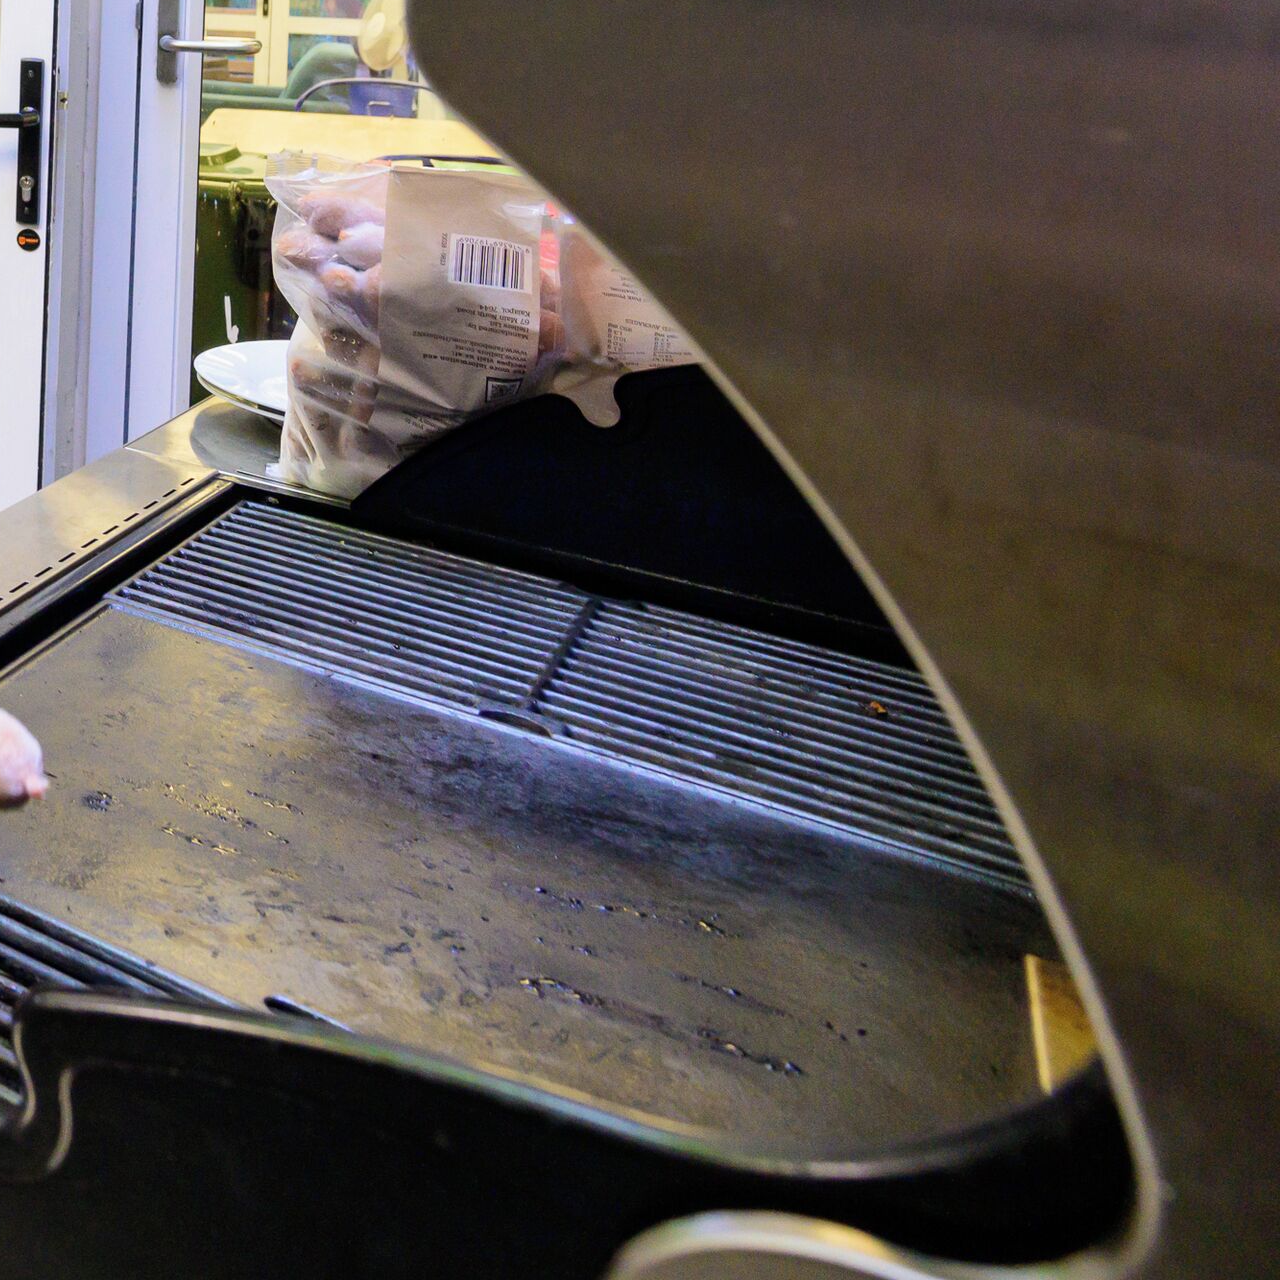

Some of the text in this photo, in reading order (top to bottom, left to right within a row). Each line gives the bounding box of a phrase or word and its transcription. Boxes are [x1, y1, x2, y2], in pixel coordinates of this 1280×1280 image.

[479, 304, 498, 312] 7644
[477, 310, 498, 320] North
[499, 314, 519, 324] Main
